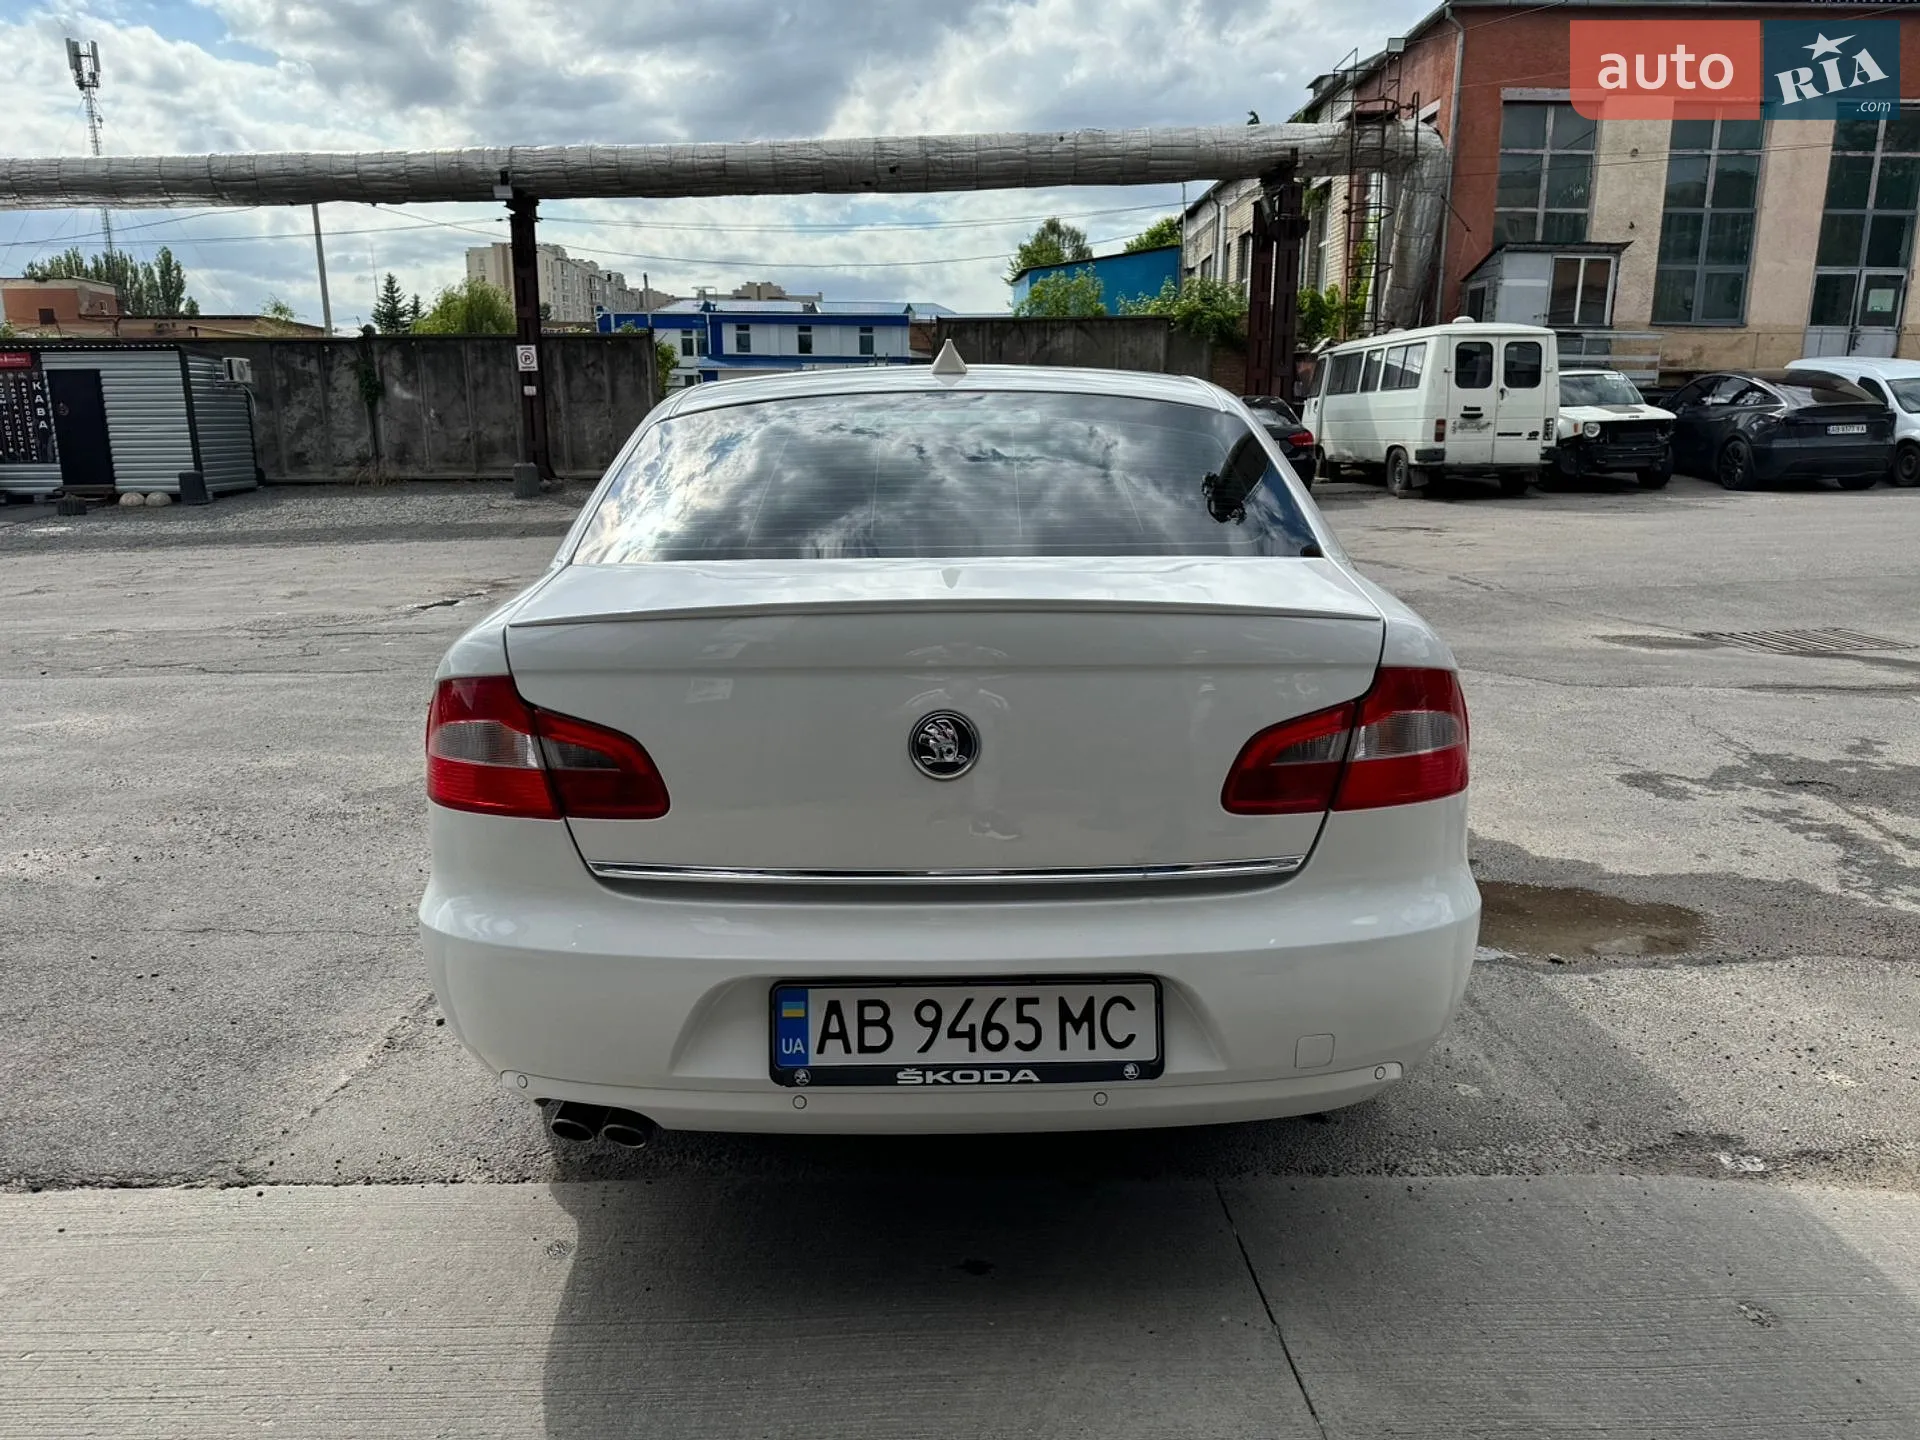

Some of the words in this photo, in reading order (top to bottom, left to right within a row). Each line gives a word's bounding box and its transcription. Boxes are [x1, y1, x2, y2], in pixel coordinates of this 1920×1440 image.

[32, 381, 48, 430] КАВА
[816, 999, 895, 1055] AB
[914, 997, 1043, 1054] 9465
[1058, 995, 1137, 1051] MC
[782, 1038, 805, 1055] UA
[896, 1067, 1041, 1085] ŠKODA
